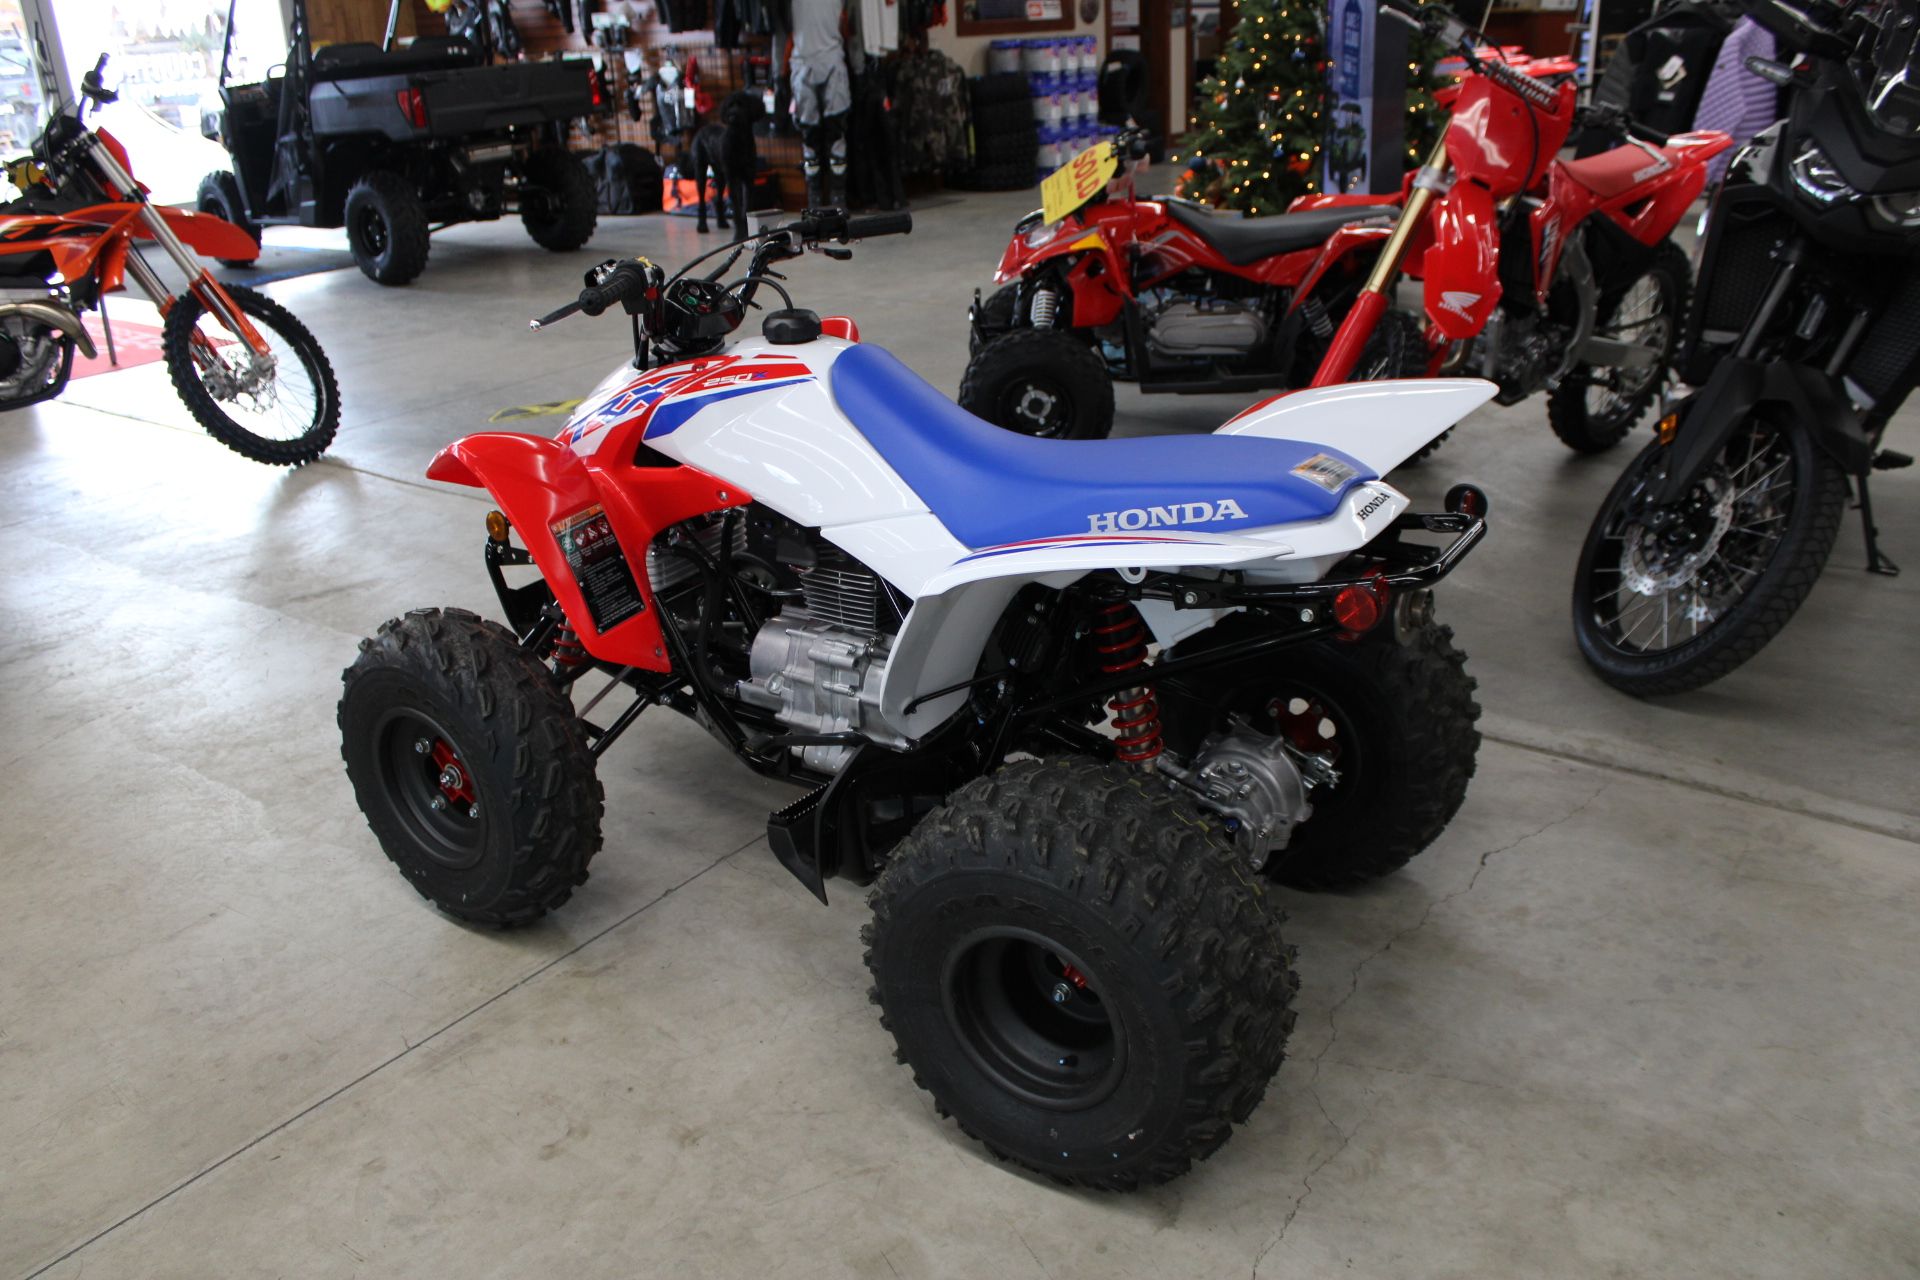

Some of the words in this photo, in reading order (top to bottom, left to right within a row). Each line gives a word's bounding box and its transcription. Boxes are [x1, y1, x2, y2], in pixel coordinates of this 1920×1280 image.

[1073, 149, 1101, 200] SOLD
[702, 372, 768, 388] 250X
[1087, 499, 1249, 534] HONDA
[1357, 492, 1391, 520] HONDA
